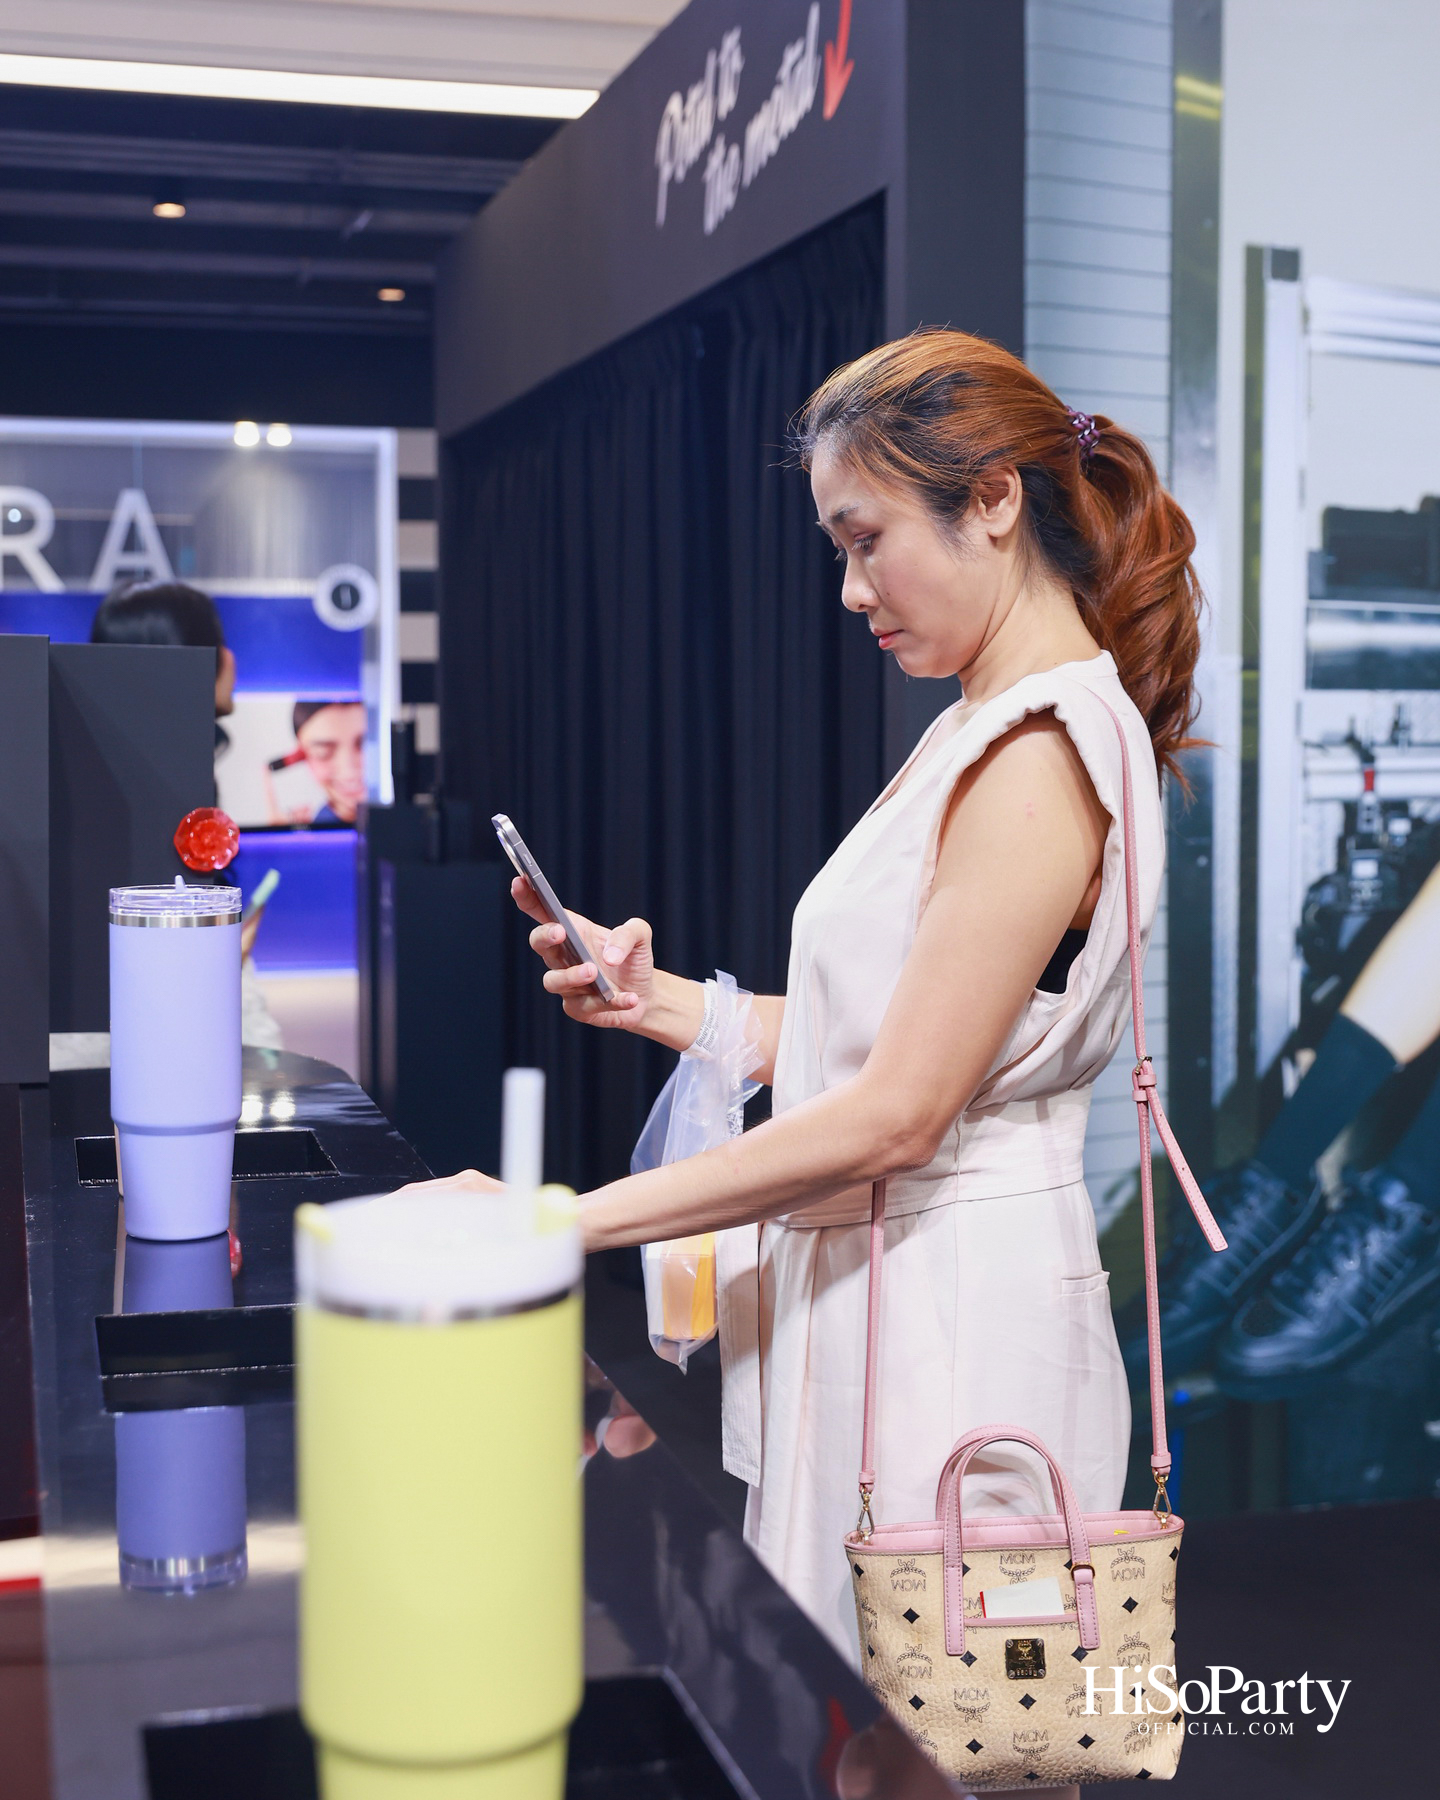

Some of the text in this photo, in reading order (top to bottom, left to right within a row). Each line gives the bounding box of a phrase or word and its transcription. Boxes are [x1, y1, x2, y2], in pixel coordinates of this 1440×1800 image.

[1000, 1553, 1035, 1565] MCM
[1111, 1566, 1145, 1582] MCM
[891, 1579, 926, 1592] MCM
[899, 1665, 932, 1680] MCM
[953, 1687, 990, 1700] MCM
[1012, 1729, 1049, 1744] MCM
